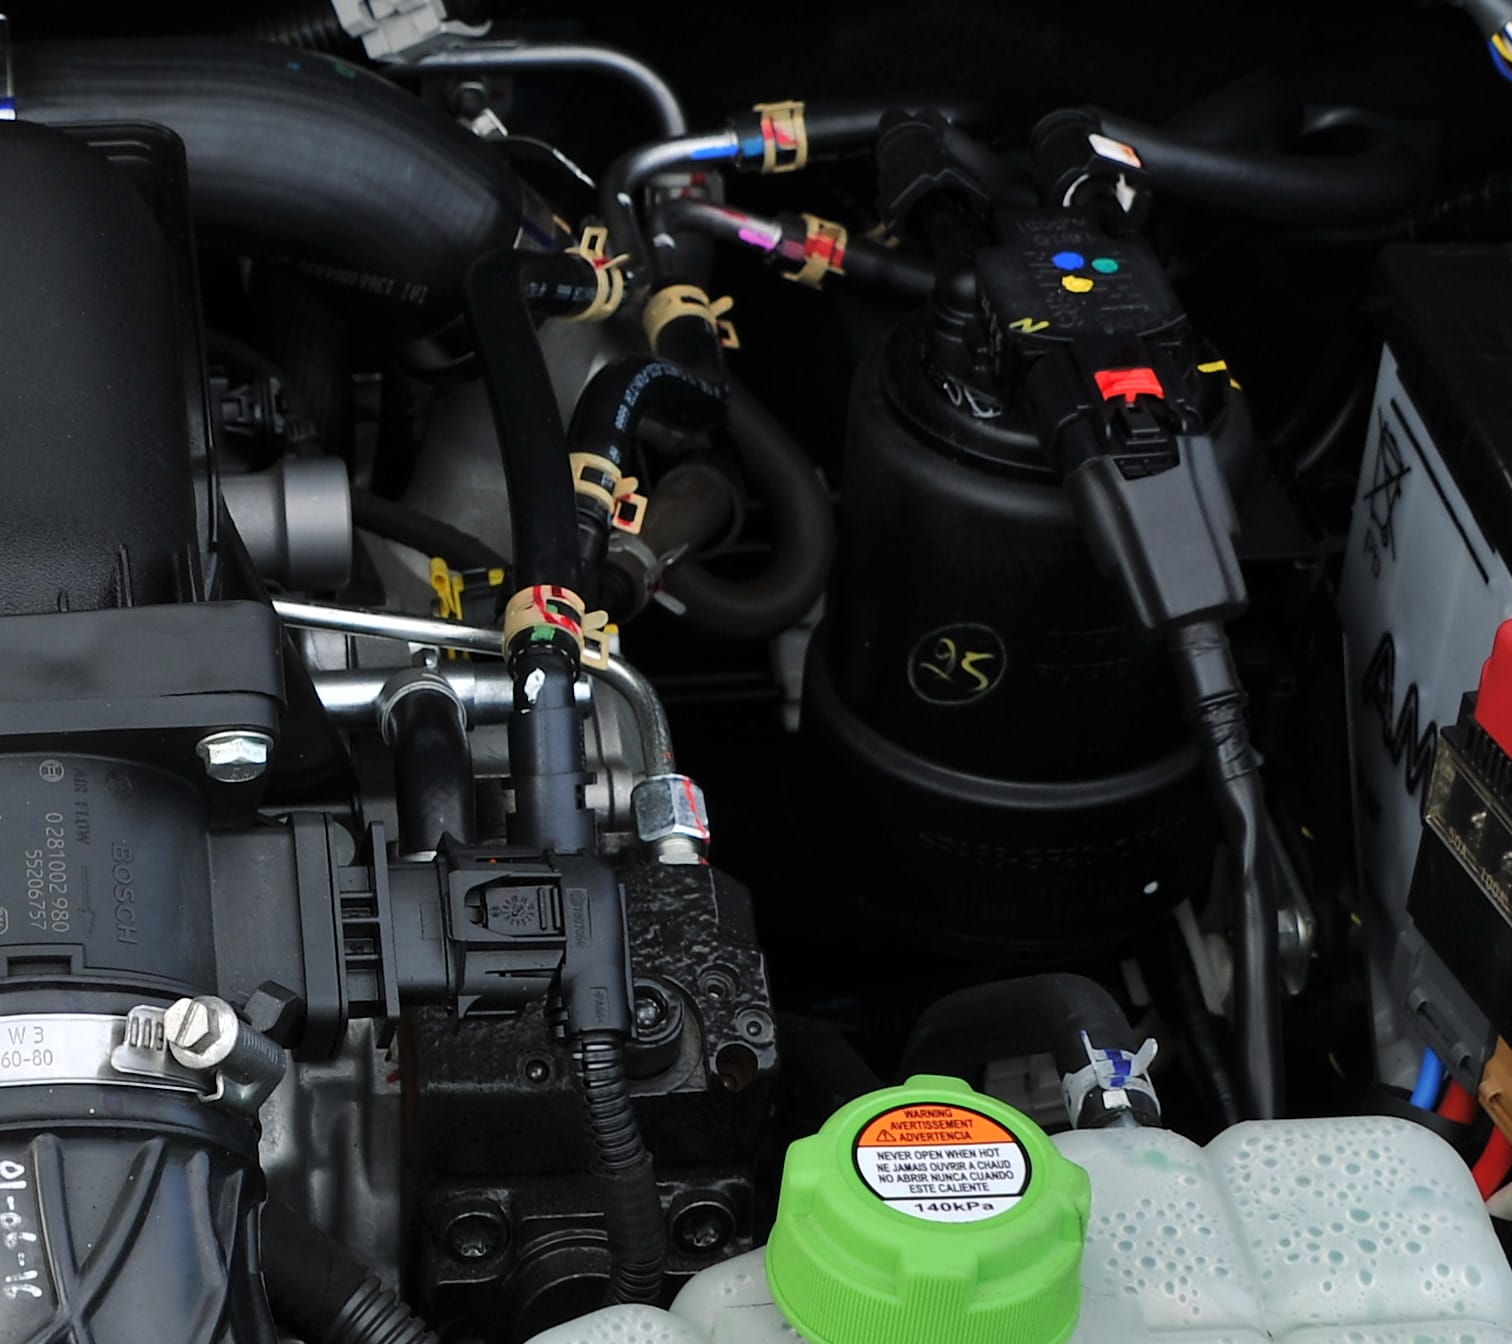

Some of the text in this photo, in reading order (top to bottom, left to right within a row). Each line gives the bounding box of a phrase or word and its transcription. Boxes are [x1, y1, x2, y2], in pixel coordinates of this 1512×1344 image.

[71, 765, 90, 844] AIR FLOW
[25, 849, 46, 929] 55206757
[111, 842, 138, 946] BOSCH
[0, 1048, 53, 1068] 60-80
[903, 1108, 953, 1119] WARNING
[890, 1118, 972, 1130] AVERTISSEMENT
[899, 1130, 972, 1142] ADVERTENCIA
[876, 1147, 999, 1160] NEVER OPEN WHEN HOT
[876, 1159, 1010, 1172] NE JAMAIS OUVRIR A CHAUD
[878, 1170, 1014, 1183] NO ABRIR NUNCA CUANDO
[908, 1182, 989, 1193] ESTE CALIENTE
[915, 1201, 993, 1211] 140kPa
